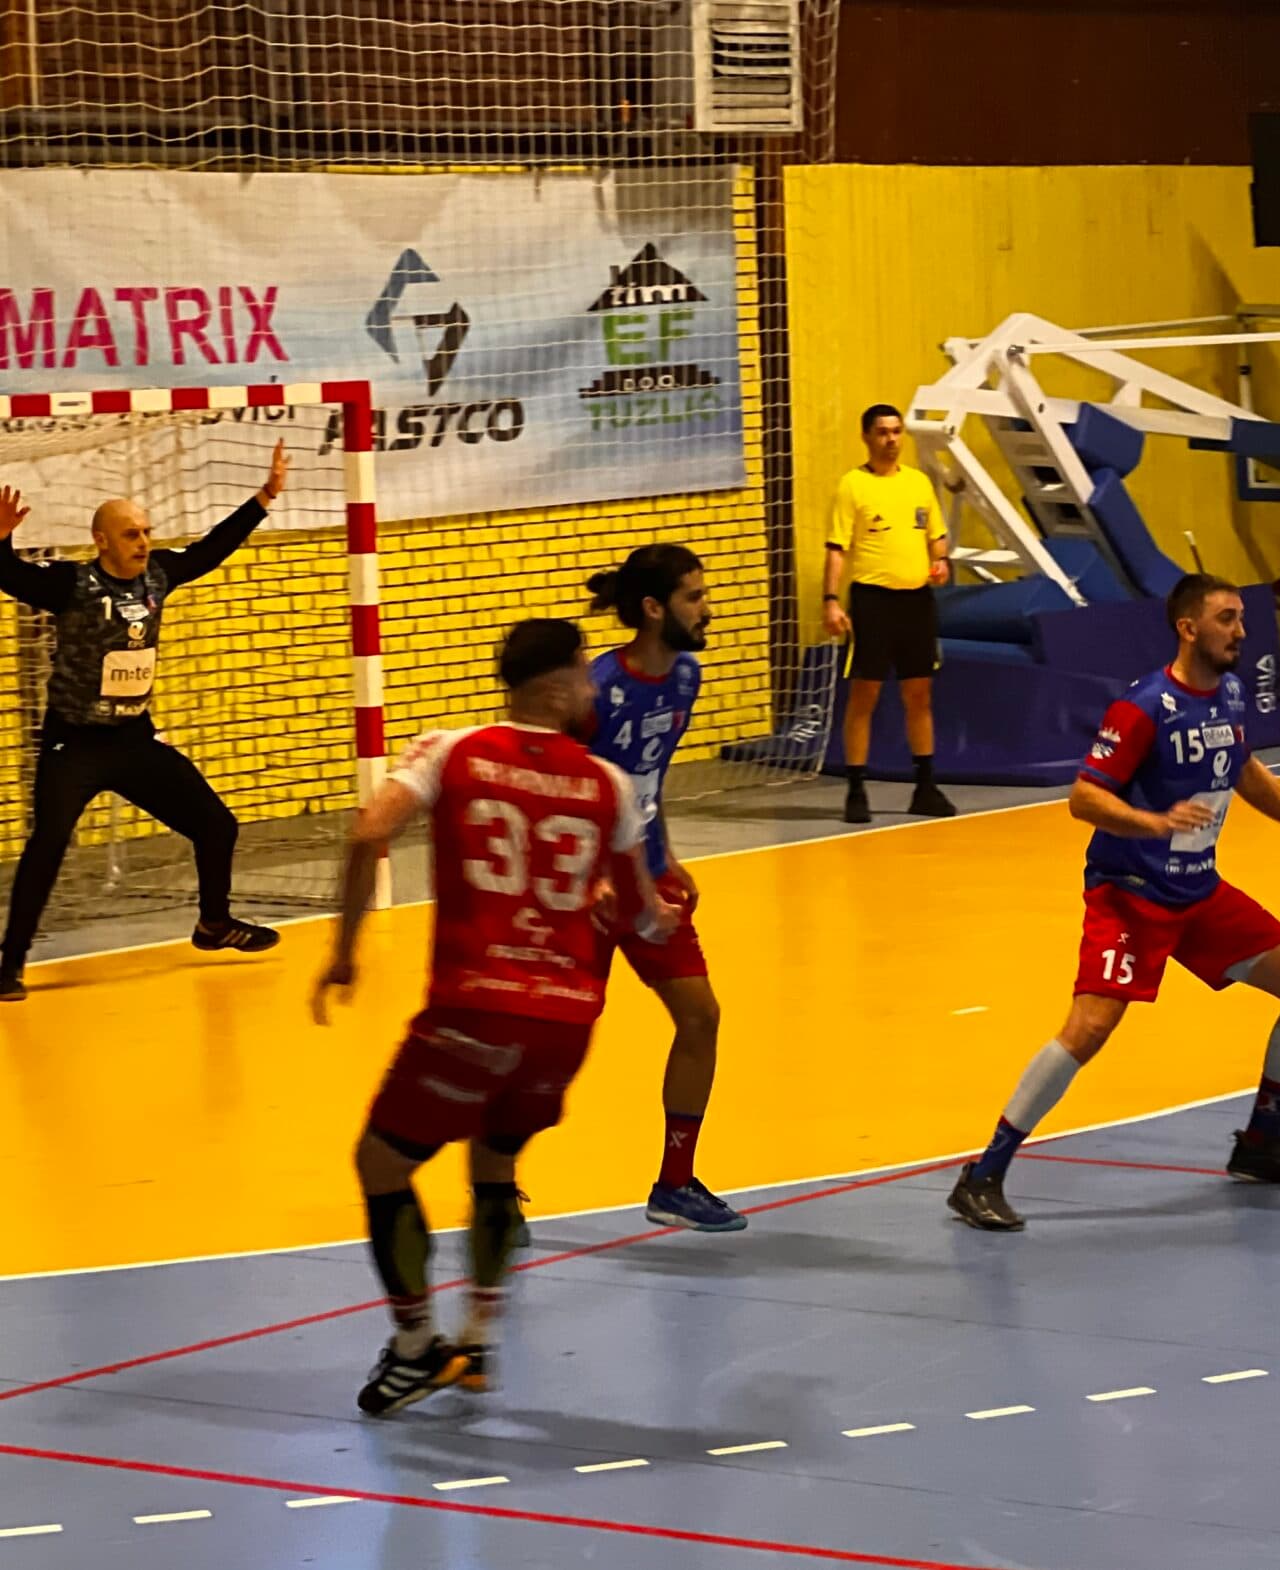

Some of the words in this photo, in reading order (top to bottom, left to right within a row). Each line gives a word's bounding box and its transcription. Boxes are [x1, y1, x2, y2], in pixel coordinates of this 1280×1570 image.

[0, 286, 290, 369] MATRIX
[101, 596, 112, 620] 1
[613, 720, 632, 750] 4
[1169, 728, 1205, 764] 15
[462, 798, 602, 913] 33
[1101, 949, 1136, 984] 15
